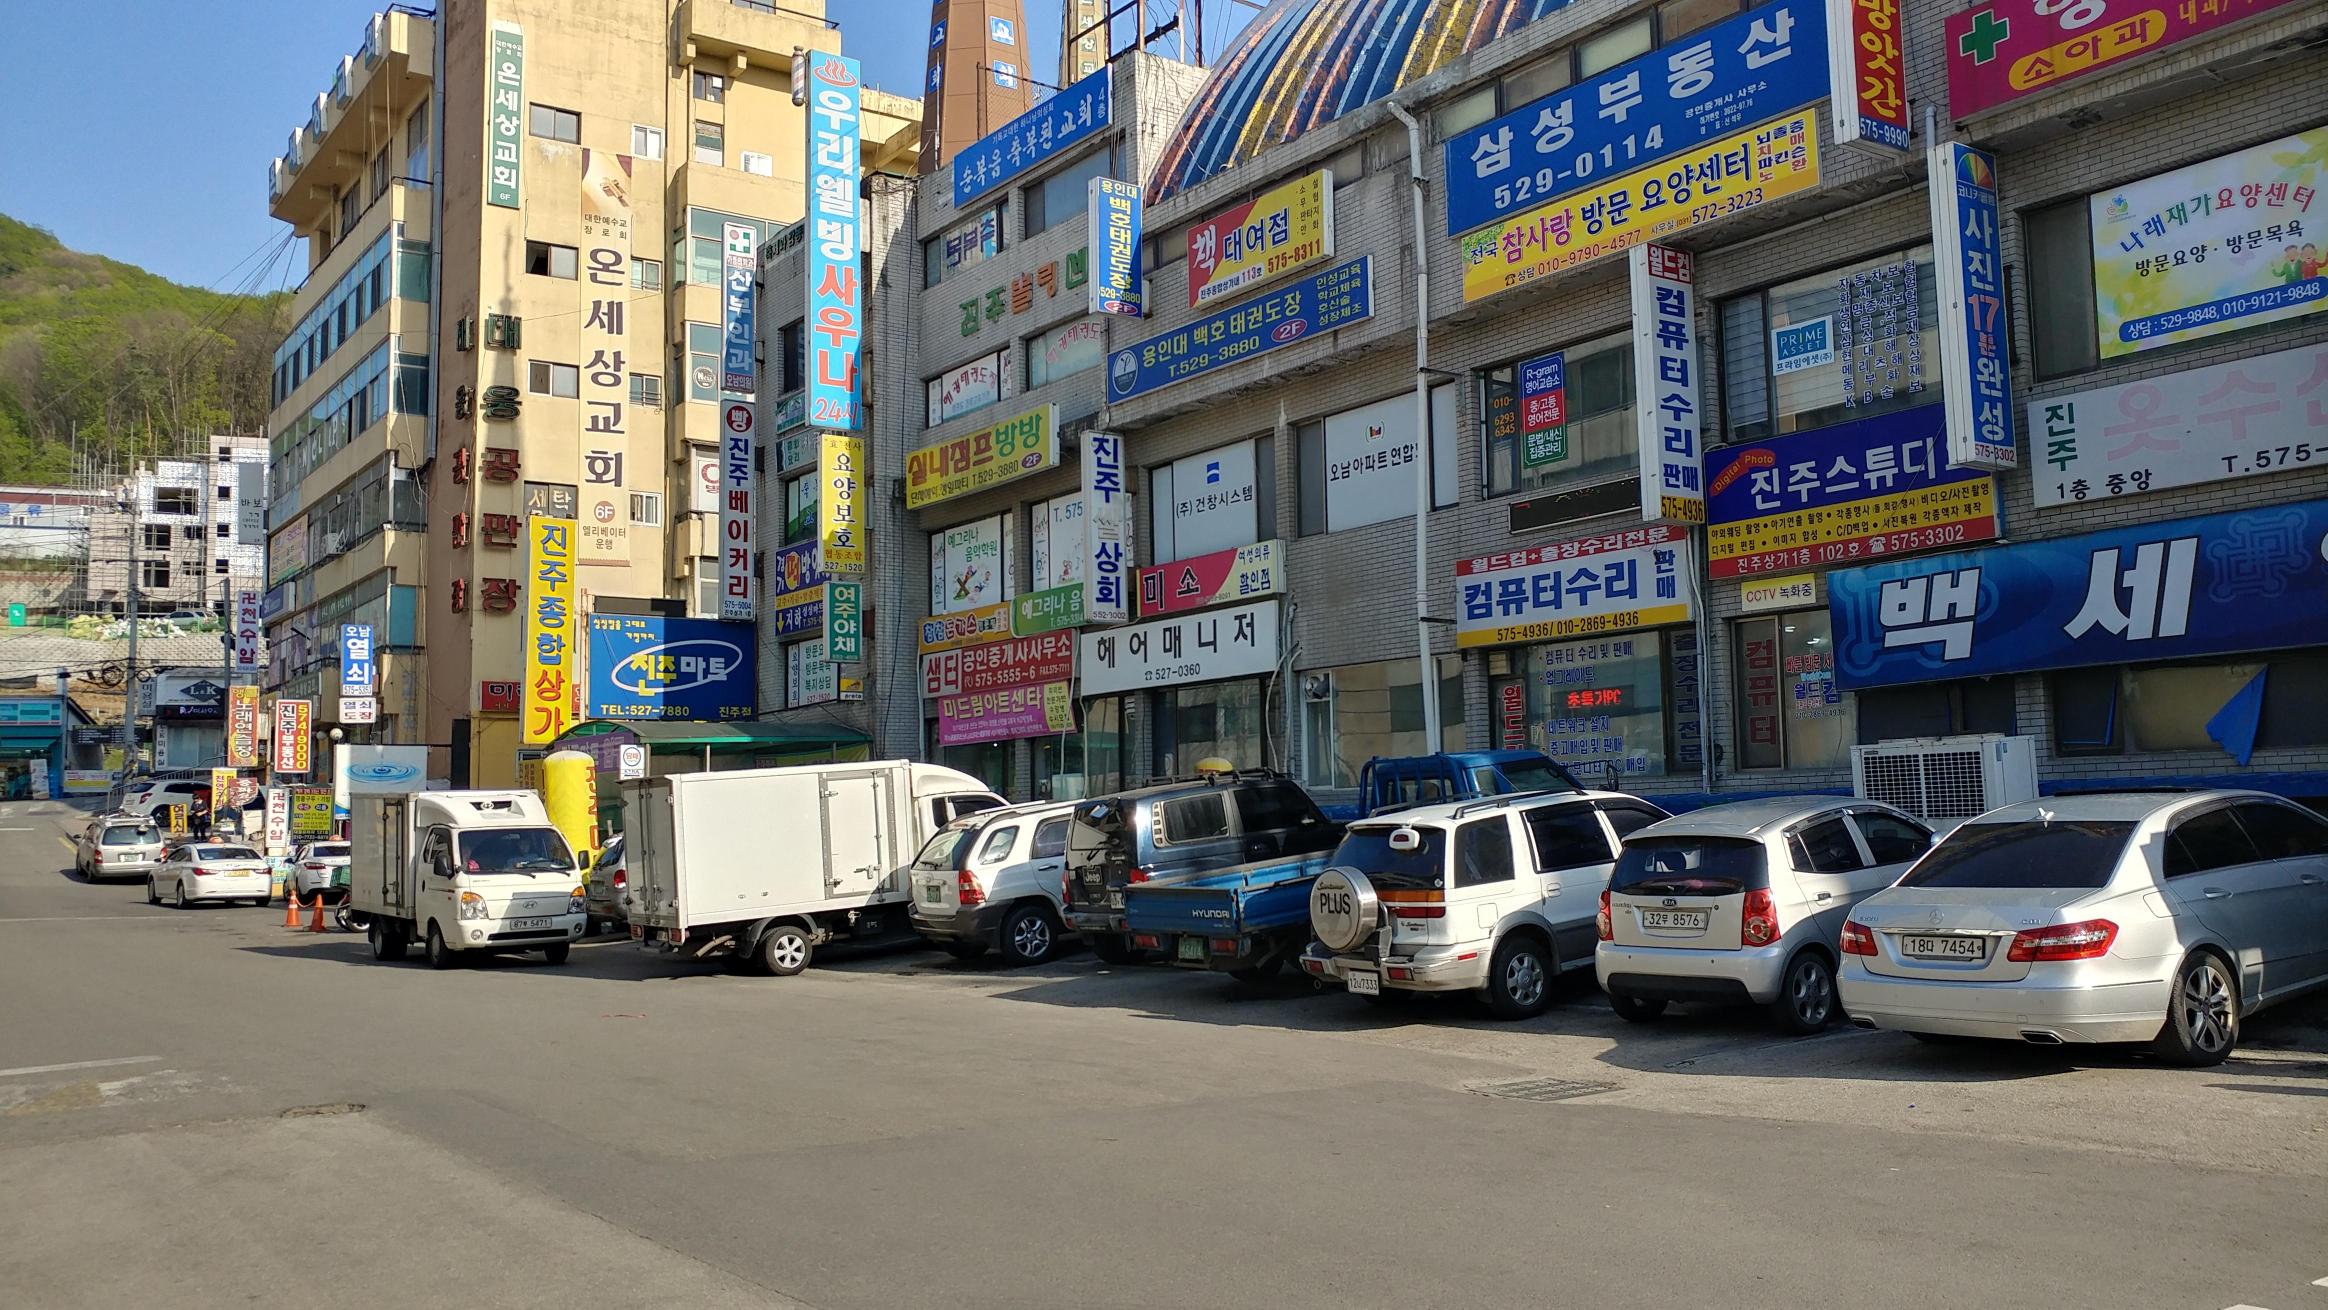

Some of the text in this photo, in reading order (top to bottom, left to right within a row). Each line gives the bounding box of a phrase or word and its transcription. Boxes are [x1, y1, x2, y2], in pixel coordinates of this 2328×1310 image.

[2023, 17, 2152, 84] 소아과
[1470, 8, 1795, 179] 삼성부동산
[1737, 80, 1768, 98] 사무소
[494, 61, 520, 189] 온세상교회
[1859, 118, 1908, 148] 575-9990
[959, 86, 1106, 194] 순복음 축복된 교회 4층
[1495, 124, 1665, 209] 529-0114
[1758, 145, 1806, 170] 파킨슨
[499, 192, 511, 201] 6F
[1101, 180, 1137, 200] 용인대
[1470, 142, 1752, 265] 전국 참사랑 방문 요양센터
[584, 213, 627, 229] 대한예수교
[1300, 204, 1320, 222] 판타지
[584, 224, 627, 240] 장로회
[1108, 198, 1132, 290] 백호태권도장
[1191, 207, 1289, 274] 책 대여점
[1517, 187, 1764, 282] 상담 010-9790-4577 572-3223
[1267, 238, 1321, 273] 575-8311
[2135, 219, 2304, 277] 방문요양 방문목욕
[1242, 267, 1263, 284] 113호
[1316, 263, 1362, 290] 인성교육
[1649, 248, 1691, 284] 월드컴
[1838, 259, 1916, 290] 자동차보험
[1099, 286, 1141, 303] 529-3880
[1110, 302, 1133, 314] 2F
[1318, 295, 1351, 314] 호신술
[728, 269, 752, 372] 산부인과
[1319, 302, 1363, 326] 성장체조
[2128, 281, 2321, 339] 상담 010-9121-9848
[815, 264, 858, 393] 사우나
[1142, 291, 1302, 368] 용인대 백호 태권도장
[1780, 327, 1824, 347] PRIME
[1965, 207, 2006, 442] 사진 17분 완성
[1169, 323, 1301, 378] T.529-3880 2F
[1782, 341, 1821, 357] ASSET
[584, 247, 626, 488] 온세상교회
[1526, 362, 1558, 380] R-gram
[1656, 286, 1694, 458] 컴퓨터수리
[726, 374, 753, 389] 오남의원
[1525, 375, 1561, 394] 영어교습소
[814, 398, 858, 427] 24시
[1493, 396, 1514, 409] 010-
[1530, 395, 1557, 413] 중/고등
[731, 407, 750, 431] 빵
[1494, 411, 1515, 427] 6293
[1495, 424, 1516, 438] 6345
[1527, 408, 1559, 427] 영어전문
[1527, 427, 1563, 447] 문법/내신
[1529, 441, 1562, 460] 집중관리
[2045, 402, 2079, 472] 진주
[1024, 454, 1039, 466] 2F
[1974, 444, 2015, 463] 575-3302
[1093, 437, 1121, 503] 진주
[1662, 462, 1699, 492] 판매
[1713, 454, 1774, 491] Digital Photo
[2056, 468, 2153, 501] 1층 중앙
[595, 505, 614, 518] 6F
[832, 453, 857, 549] 요양보호
[1195, 485, 1254, 513] 건창시스템
[1661, 496, 1704, 522] 575-4936
[480, 446, 522, 612] 공판장
[727, 437, 750, 599] 진주베이커리
[1745, 523, 1760, 535] 촬영
[1836, 503, 1870, 521] 각종행사
[1772, 501, 1982, 546] 이미지 제작
[582, 525, 627, 539] 엘리베이터
[595, 537, 614, 550] 운행
[1891, 523, 1966, 551] 575-3302
[825, 549, 863, 561] 협동조합
[965, 541, 998, 563] 음악학원
[1238, 544, 1270, 564] 여성의류
[824, 561, 863, 572] 527-1520
[1094, 542, 1123, 609] 상회
[1655, 549, 1676, 599] 판매
[1144, 566, 1200, 609] 미소
[1239, 568, 1271, 595] 할인점
[1464, 558, 1638, 621] 컴퓨터수리
[1746, 582, 1813, 604] CCTV 녹화중
[346, 626, 370, 638] 오남
[533, 523, 568, 737] 진주종합상가
[785, 607, 802, 631] 지하
[834, 586, 858, 653] 여주야채
[1557, 611, 1639, 635] 010-2869-4936
[963, 634, 1071, 672] 공인중개사사무소
[1097, 612, 1255, 669] 헤어매니저
[1577, 644, 1609, 661] 수리 및
[346, 638, 370, 685] 열쇠
[926, 650, 960, 693] 샘터
[1155, 663, 1201, 680] 527-0360
[975, 665, 1036, 687] 575-5555~6
[1745, 639, 1778, 745] 컴퓨터
[344, 711, 372, 720] 도장
[600, 703, 752, 718] TEL:527-7880 진주점
[281, 704, 296, 769] 진주부동산
[296, 704, 308, 769] 574-9000
[270, 802, 286, 840] 천수암
[1085, 872, 1101, 883] Jeep
[1192, 909, 1230, 919] HYUNDAI
[1320, 893, 1351, 915] PLUS
[530, 919, 548, 928] 5471
[1673, 913, 1700, 927] 8576
[1941, 939, 1975, 955] 7454
